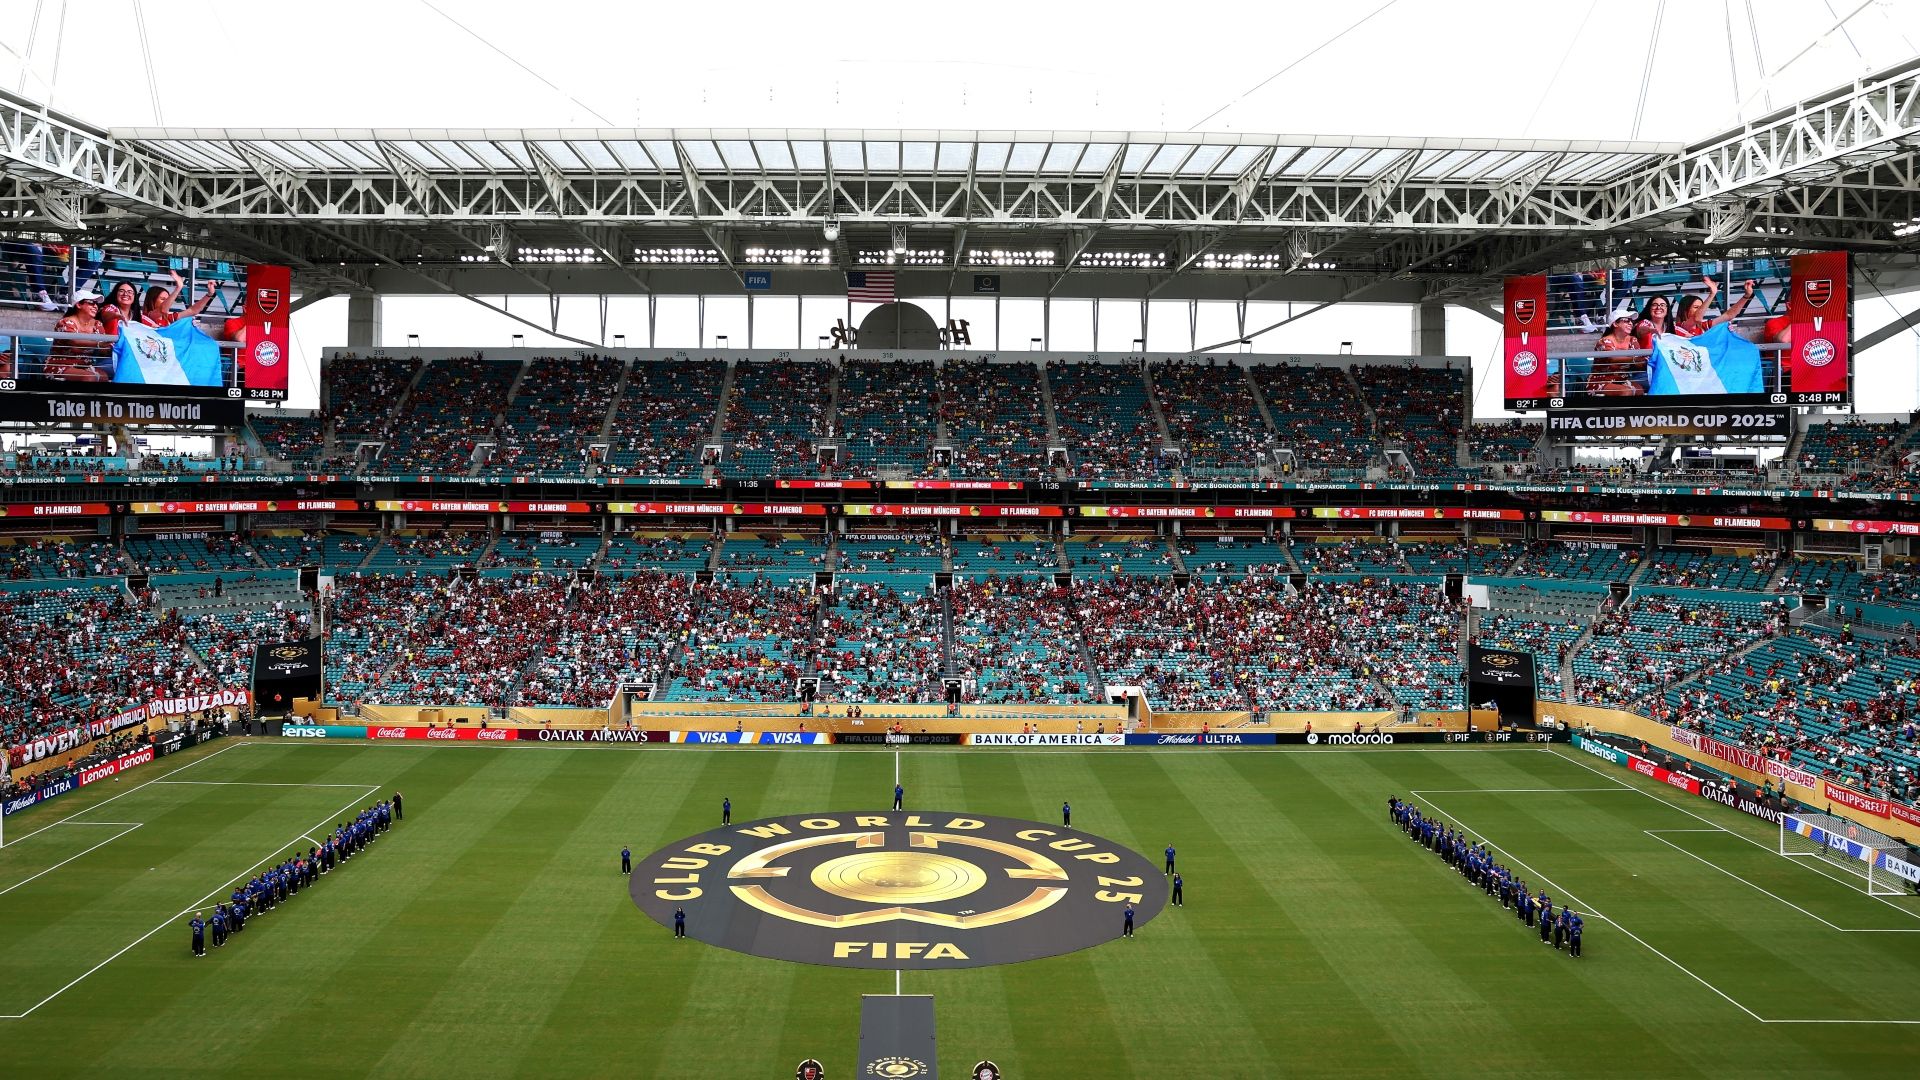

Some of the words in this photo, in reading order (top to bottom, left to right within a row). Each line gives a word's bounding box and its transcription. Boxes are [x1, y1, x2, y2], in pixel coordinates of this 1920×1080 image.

[749, 276, 767, 285] FIFA
[264, 321, 271, 335] V
[1813, 316, 1823, 332] V
[1520, 332, 1529, 345] V
[1811, 339, 1832, 351] BAYERN
[1805, 354, 1832, 365] MÜNCHEN
[229, 388, 241, 397] CC
[250, 389, 269, 398] 3:48
[271, 389, 284, 398] PM
[1798, 394, 1822, 403] 3:48
[1825, 393, 1841, 402] PM
[1516, 400, 1530, 408] 92°
[1532, 400, 1538, 408] F
[1551, 399, 1563, 407] CC
[1772, 394, 1786, 403] CC
[48, 400, 86, 418] Take
[90, 400, 101, 418] It
[105, 401, 123, 418] To
[128, 402, 154, 419] The
[159, 402, 201, 420] World
[274, 408, 286, 416] 312
[1550, 417, 1583, 430] FIFA
[1586, 416, 1626, 429] CLUB
[1629, 415, 1690, 428] WORLD
[1693, 414, 1728, 427] CUP
[1843, 414, 1860, 422] 327
[1617, 487, 1662, 495] KUECHENBERG
[34, 506, 43, 514] CR
[45, 505, 82, 514] FLAMENGO
[143, 504, 149, 512] V
[205, 503, 228, 511] BAYERN
[229, 502, 257, 511] MÜNCHEN
[696, 504, 724, 512] MÜNCHEN
[1009, 507, 1039, 515] FLAMENGO
[1369, 509, 1376, 517] FC
[1377, 509, 1397, 517] BAYERN
[1398, 508, 1425, 517] MÜNCHEN
[1472, 510, 1500, 518] FLAMENGO
[1602, 514, 1610, 522] FC
[1611, 514, 1635, 523] BAYERN
[1636, 513, 1667, 525] MÜNCHEN
[1713, 517, 1723, 526] CR
[1724, 517, 1760, 527] FLAMENGO
[1828, 521, 1834, 529] V
[149, 690, 247, 717] URUBUZADA
[202, 730, 212, 742] PIF
[539, 730, 584, 742] QATAR
[699, 732, 728, 743] VISA
[773, 733, 802, 744] VISA
[845, 735, 861, 743] FIFA
[863, 735, 882, 743] CLUB
[914, 735, 929, 743] CUP
[931, 736, 950, 744] 2025
[975, 735, 1016, 744] BANK
[1018, 735, 1035, 744] OF
[1039, 735, 1102, 745] AMERICA
[1158, 734, 1195, 744] Michelob
[1205, 734, 1241, 744] ULTRA
[1329, 733, 1394, 745] motorola
[1454, 733, 1470, 742] PIF
[1496, 733, 1511, 742] PIF
[1537, 733, 1553, 742] PIF
[22, 728, 79, 763] JOVEM
[171, 741, 182, 752] PIF
[1580, 738, 1617, 763] Hisense
[1700, 736, 1709, 754] LA
[1709, 739, 1736, 764] BESTIA
[1737, 747, 1765, 774] NEGRA
[119, 751, 151, 771] Lenovo
[82, 764, 115, 785] Lenovo
[1767, 762, 1783, 778] RED
[1783, 767, 1816, 789] POWER
[5, 793, 36, 815] Michelob
[43, 780, 71, 798] ULTRA
[1826, 785, 1889, 814] PHILIPPSREUT
[1702, 785, 1735, 807] QATAR
[1738, 799, 1782, 825] AIRWAYS
[655, 842, 732, 901] CLUB
[737, 814, 986, 840] WORLD
[1015, 829, 1121, 866] CUP
[1094, 875, 1144, 905] 25
[1887, 859, 1917, 879] BANK
[833, 941, 971, 960] FIFA
